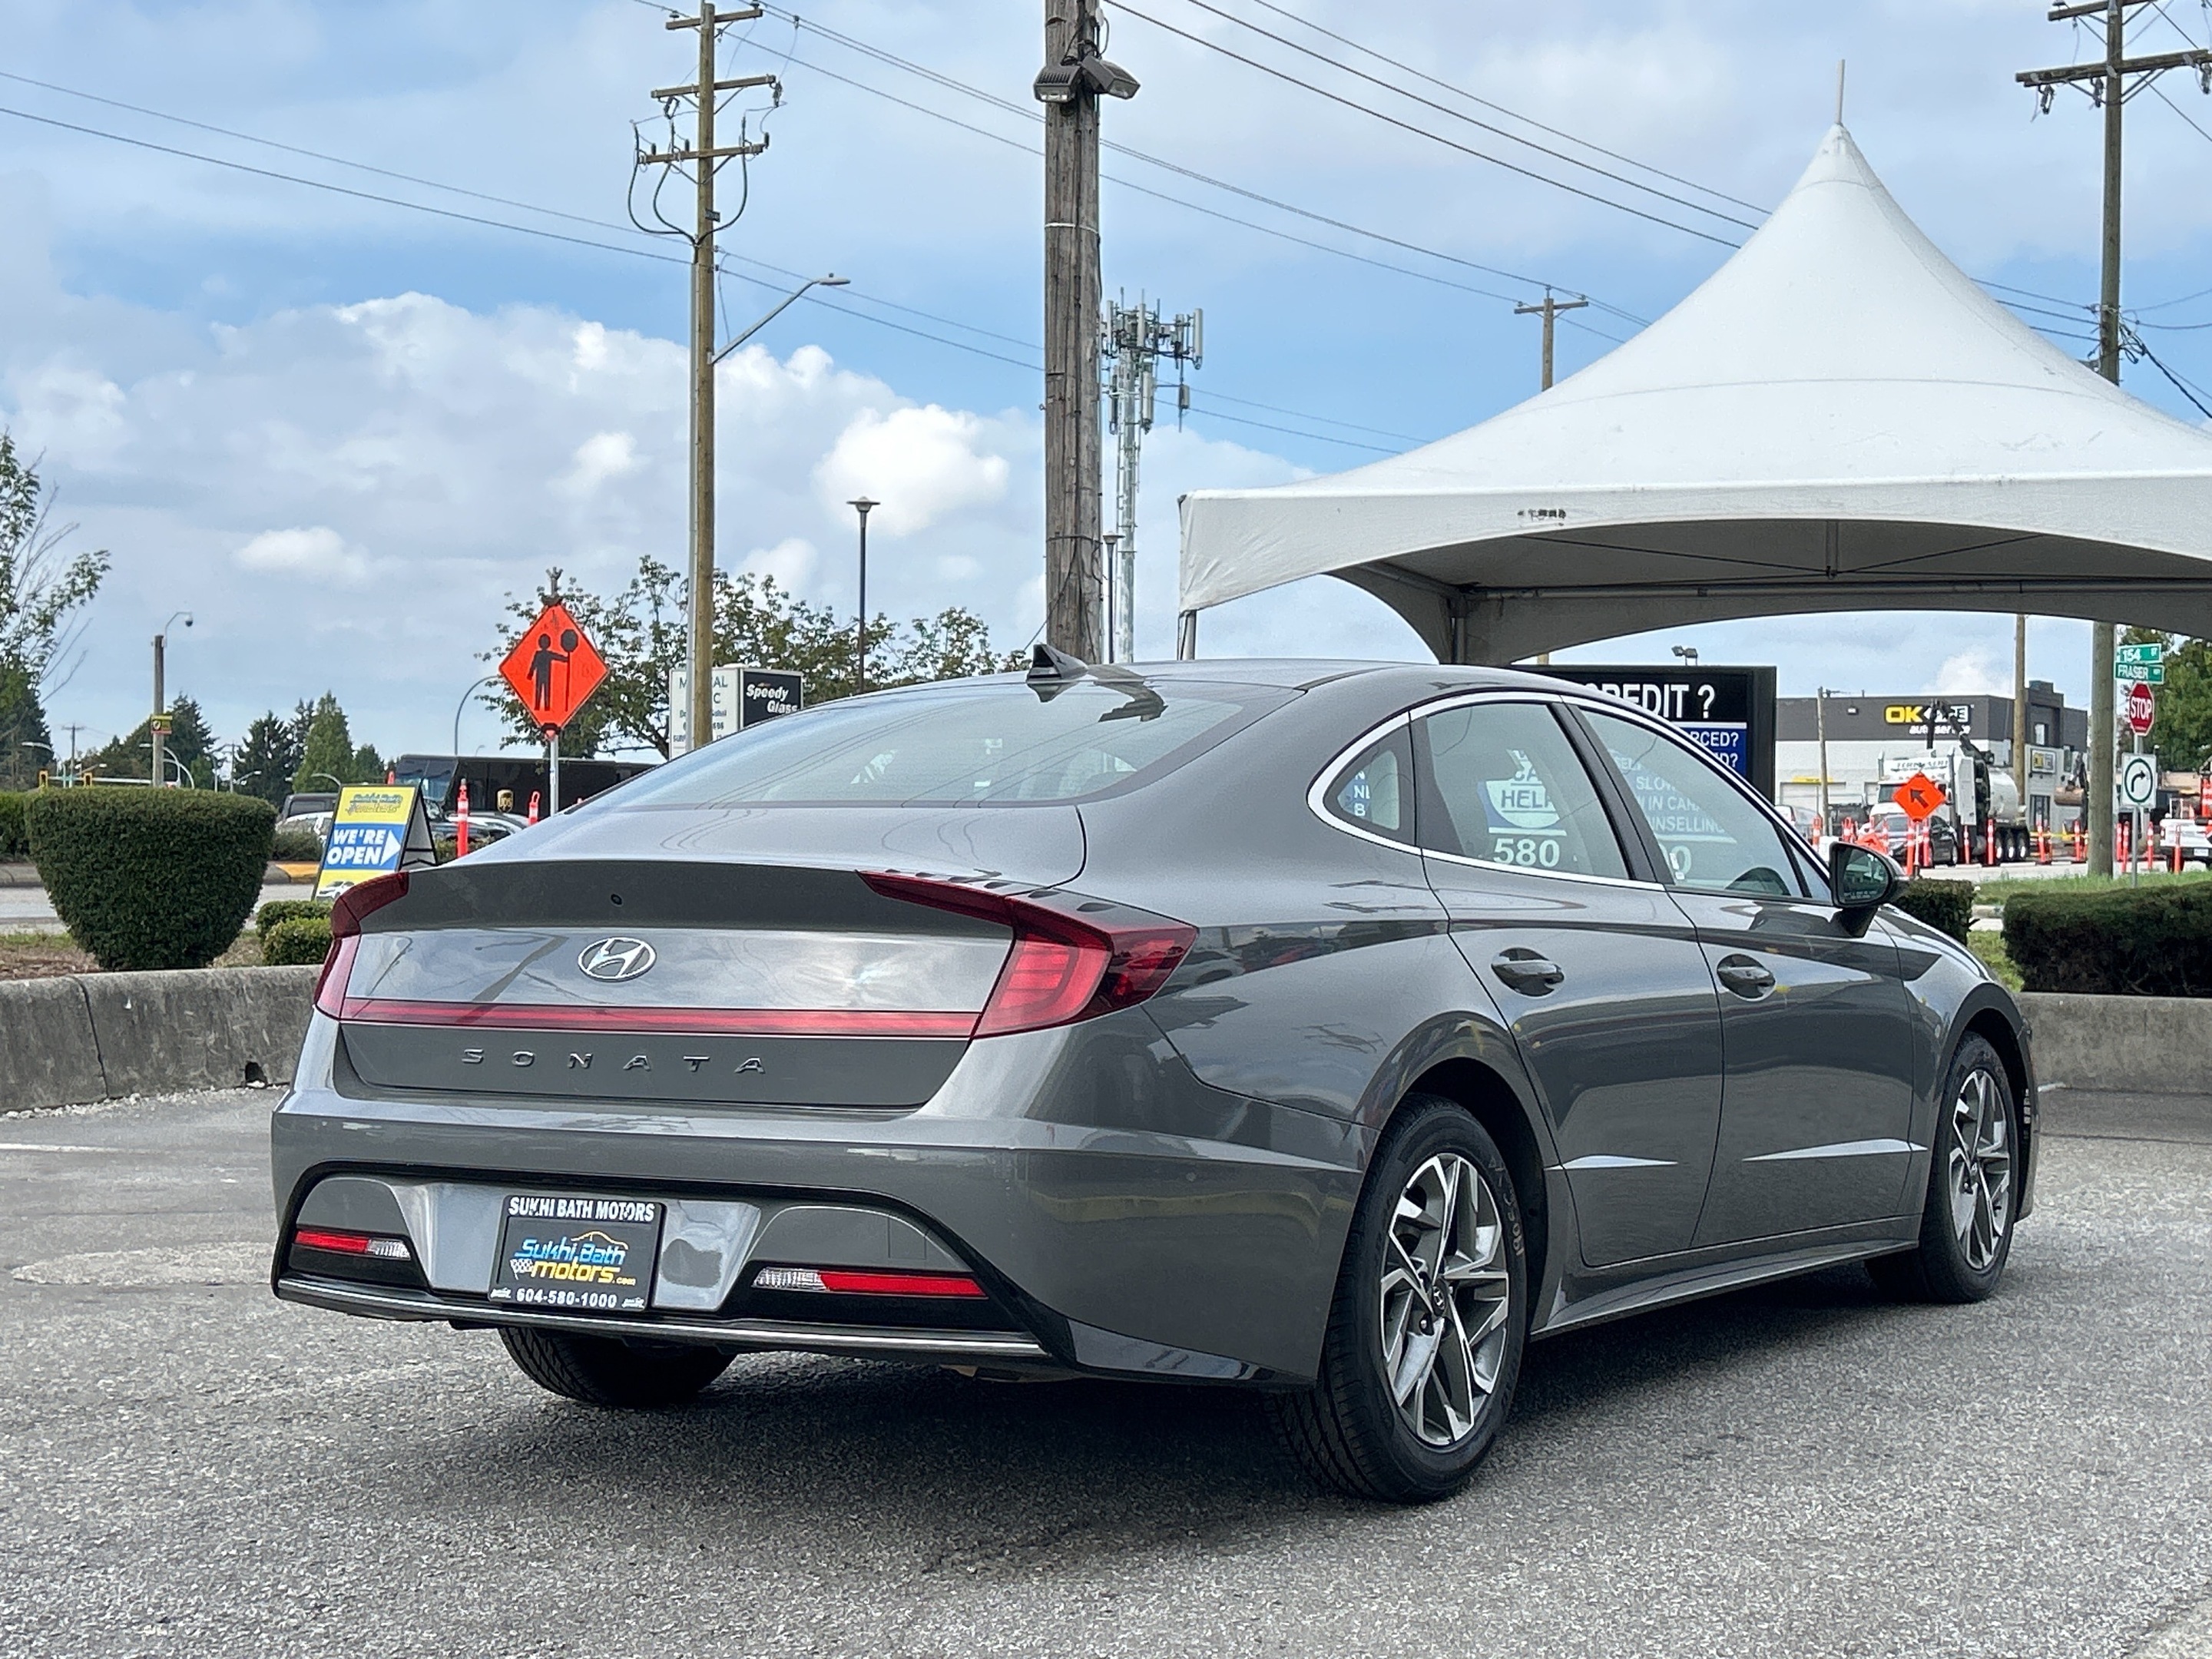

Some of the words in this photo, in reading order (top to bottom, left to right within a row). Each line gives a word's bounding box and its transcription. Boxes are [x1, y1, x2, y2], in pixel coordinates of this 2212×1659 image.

[2118, 664, 2148, 680] FRASER
[746, 683, 789, 702] Speedy
[1886, 706, 1923, 723] OK
[2131, 696, 2151, 720] STOP
[333, 829, 387, 846] WE'RE
[326, 846, 383, 866] OPEN
[1493, 837, 1561, 867] 580
[462, 1048, 766, 1075] SONATA
[508, 1197, 555, 1217] SUKHI
[557, 1199, 593, 1220] BATH
[594, 1200, 655, 1223] MOTORS
[514, 1236, 578, 1262] Sukhi
[578, 1241, 627, 1266] Bath
[516, 1288, 618, 1309] 604-580-1000
